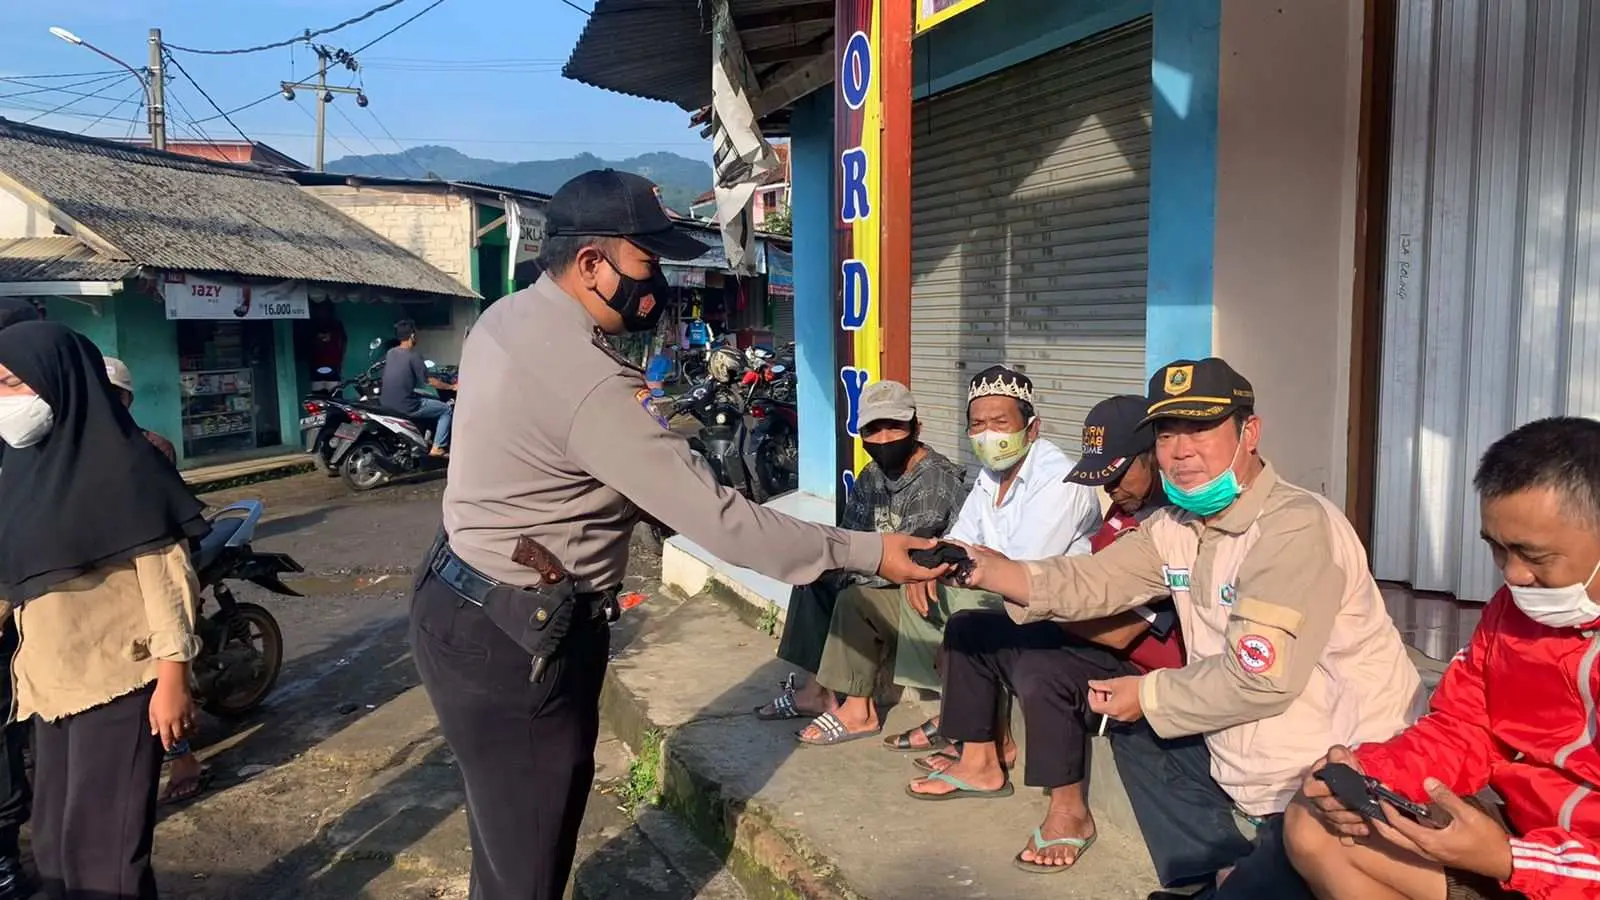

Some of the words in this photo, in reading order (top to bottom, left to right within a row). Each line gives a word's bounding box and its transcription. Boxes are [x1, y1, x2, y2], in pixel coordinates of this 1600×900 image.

[842, 31, 871, 505] ORDY
[264, 303, 291, 315] 16.000
[1072, 464, 1117, 479] POLICE
